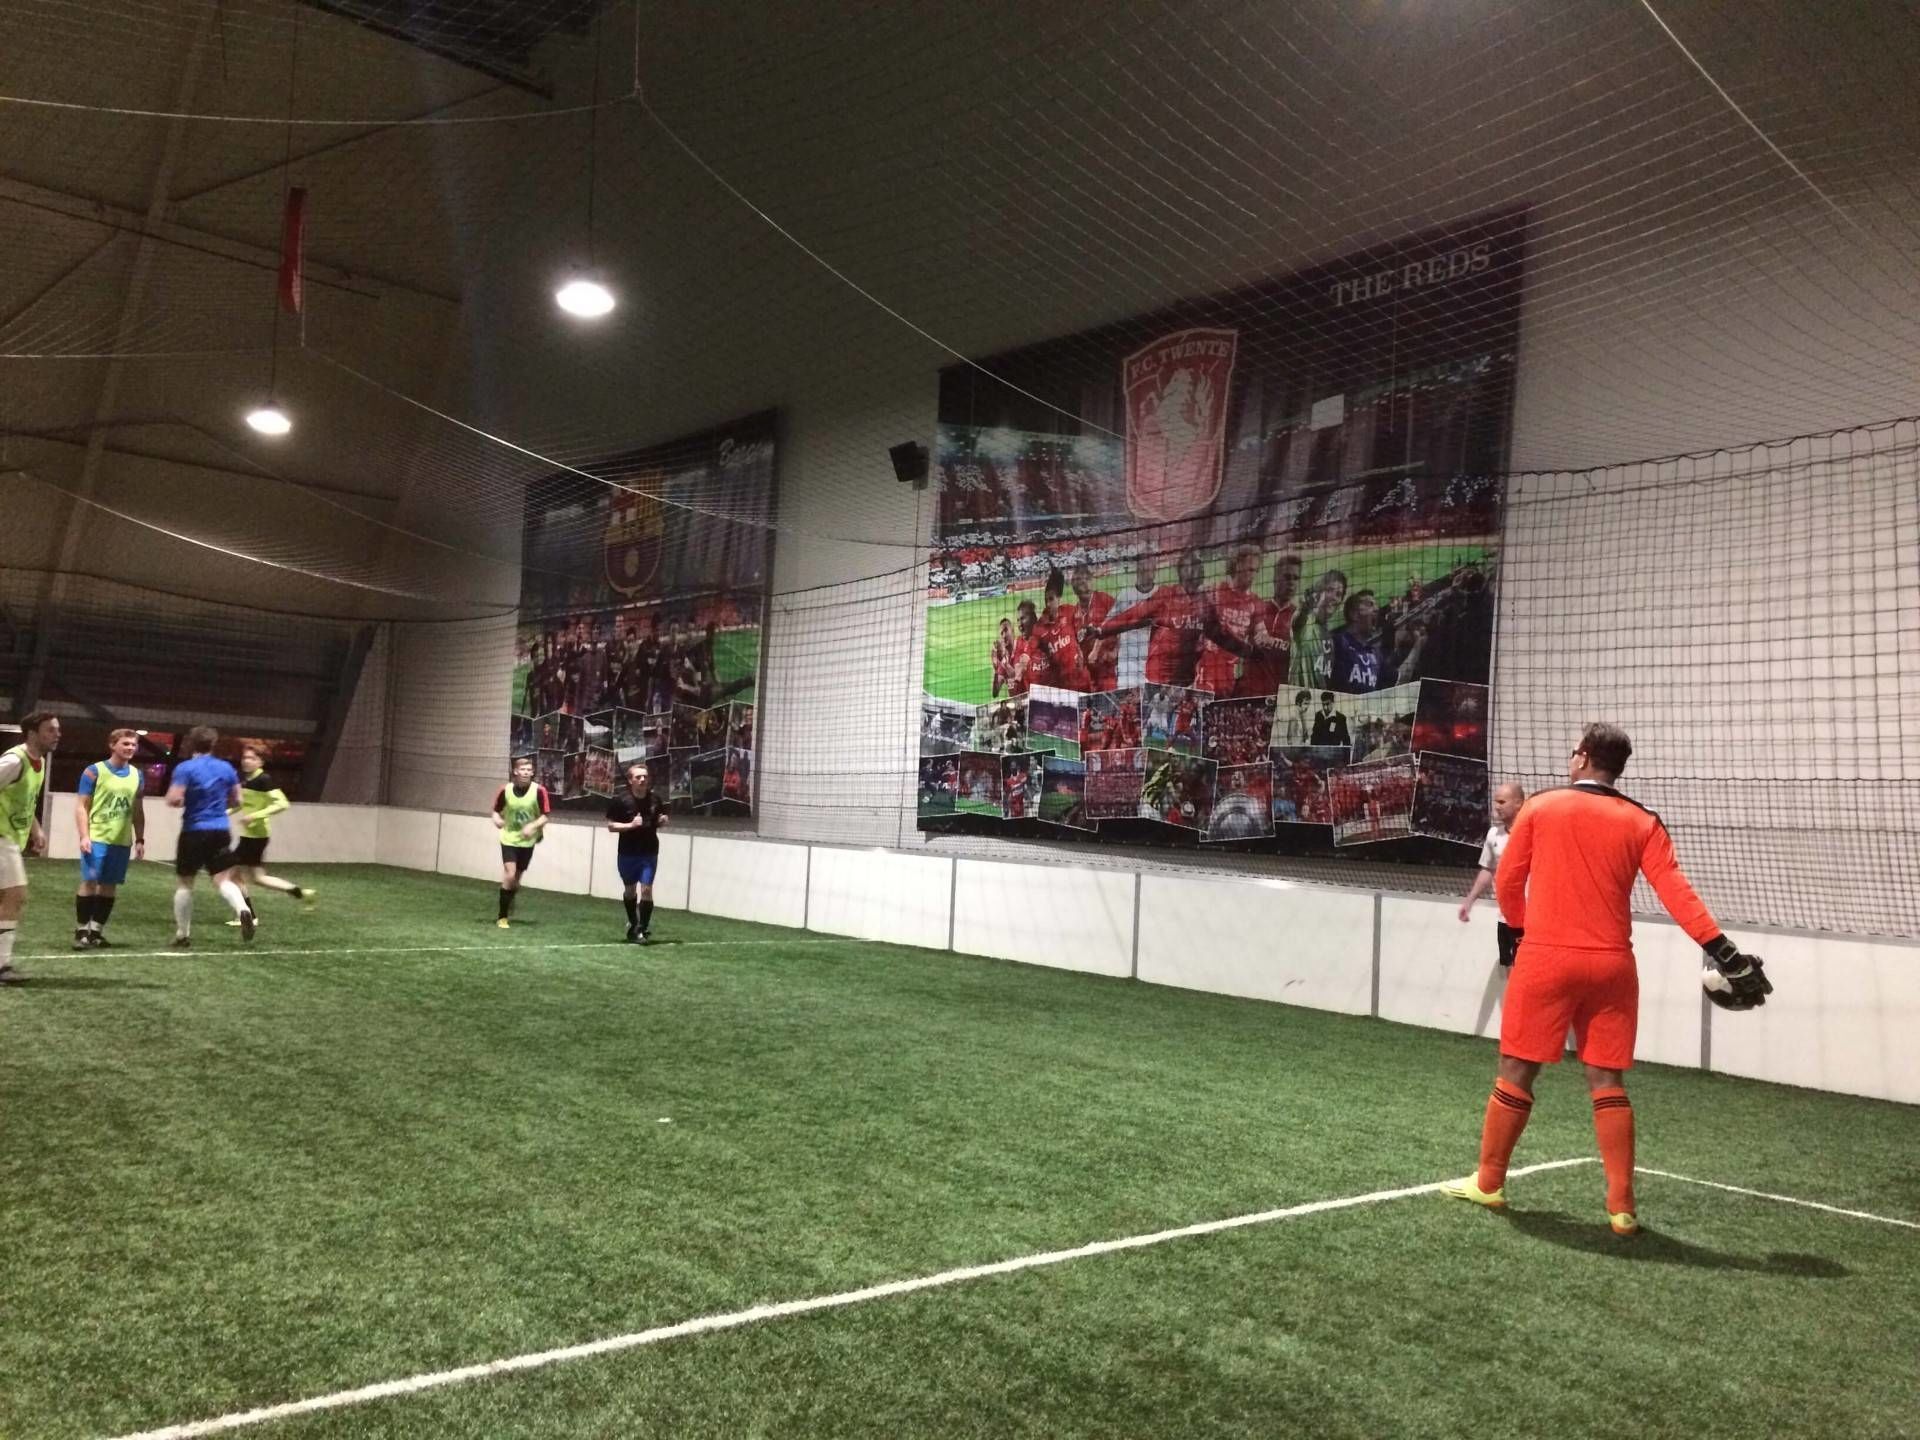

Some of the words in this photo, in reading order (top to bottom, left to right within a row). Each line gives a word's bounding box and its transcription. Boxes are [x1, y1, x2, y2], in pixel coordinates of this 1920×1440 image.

[1329, 271, 1394, 307] THE
[1402, 245, 1490, 289] REDS
[1158, 340, 1231, 363] TWENTE
